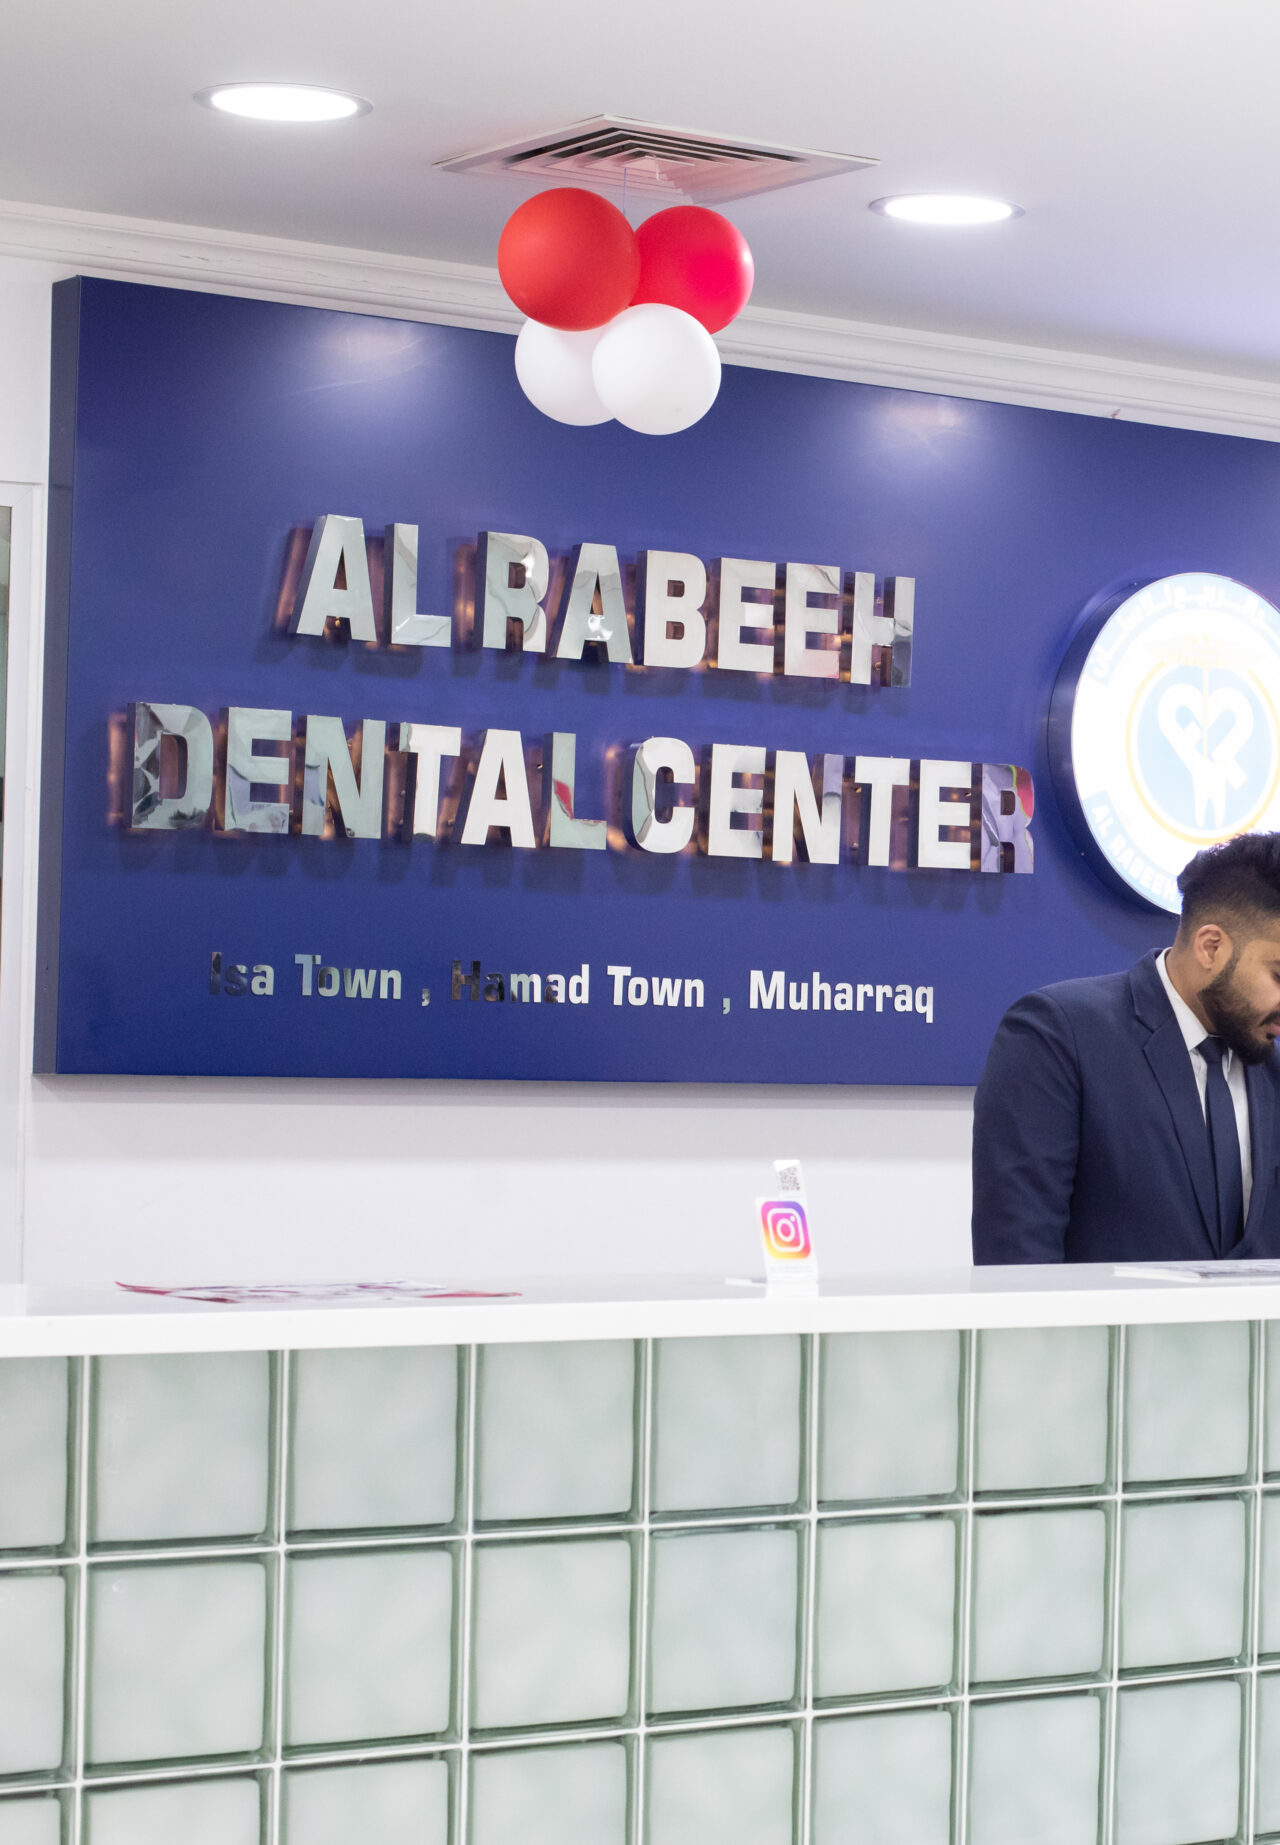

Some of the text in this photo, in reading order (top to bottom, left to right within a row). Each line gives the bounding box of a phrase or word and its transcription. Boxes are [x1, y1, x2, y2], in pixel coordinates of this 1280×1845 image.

[294, 514, 916, 688] AL RABEEH
[128, 701, 1035, 874] DENTAL CENTER
[209, 951, 275, 996] Isa
[294, 953, 402, 1000] Town
[450, 960, 590, 1005] Hamad
[607, 965, 705, 1008] Town
[750, 969, 934, 1024] Muharraq
